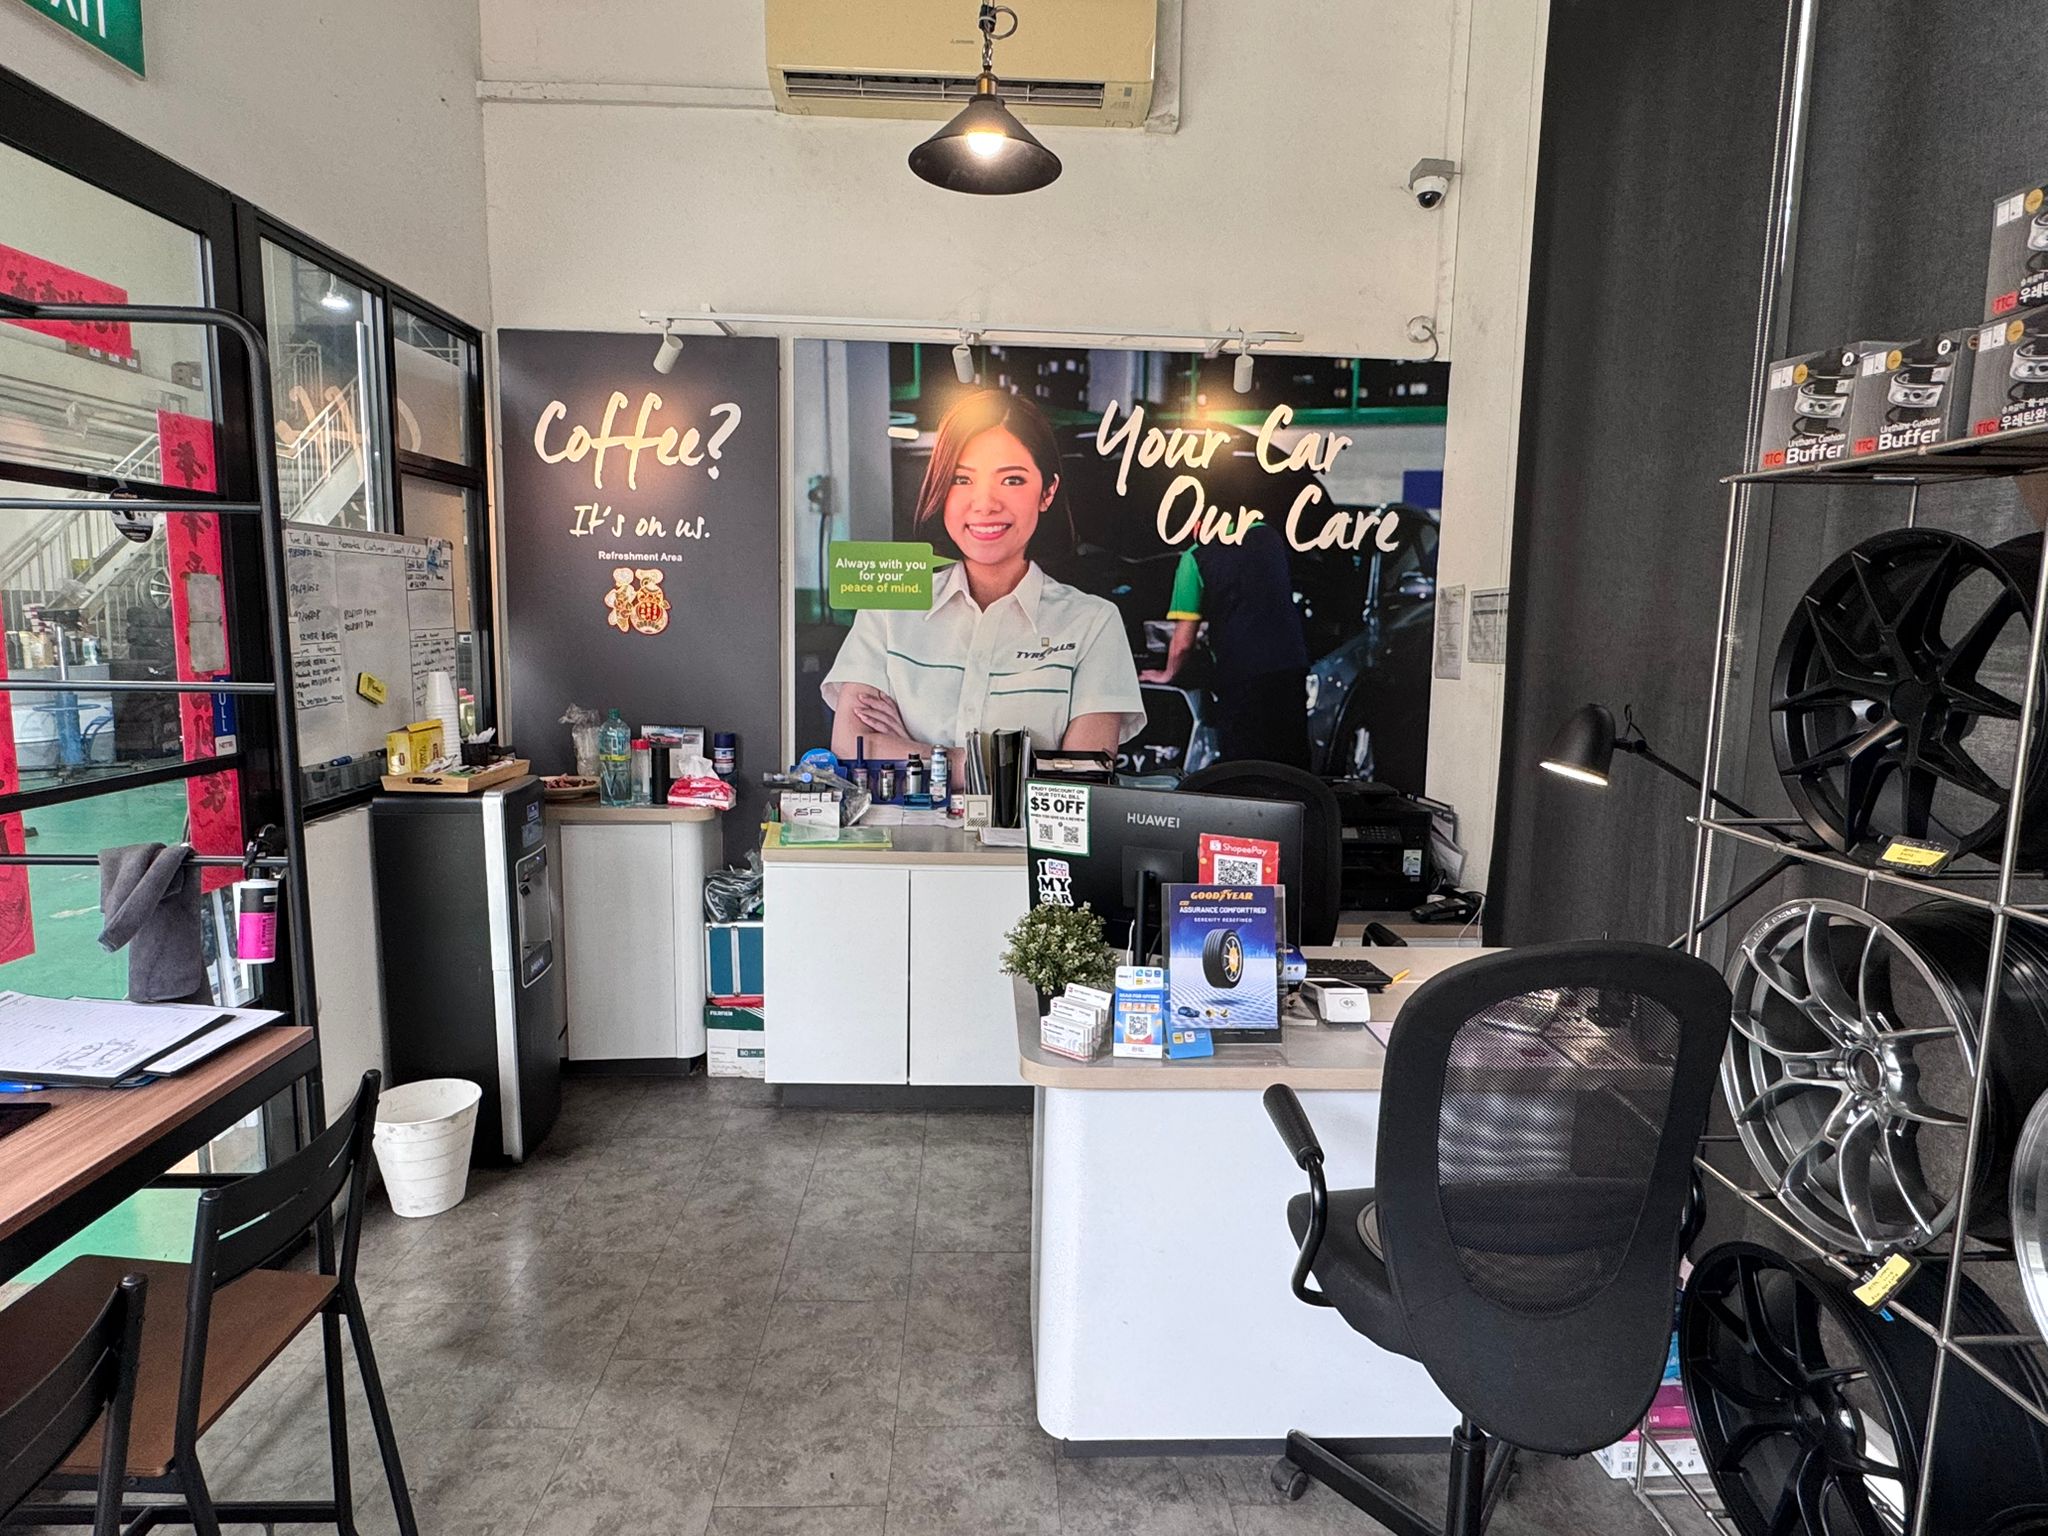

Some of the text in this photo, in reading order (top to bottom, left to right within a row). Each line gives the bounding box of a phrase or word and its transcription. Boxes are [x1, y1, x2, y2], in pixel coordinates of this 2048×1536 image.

[1912, 417, 1941, 429] Cushion
[533, 391, 742, 490] Coffee?
[1818, 432, 1846, 444] Cushion
[1878, 428, 1940, 451] Buffer
[1097, 400, 1353, 496] Your Car
[1785, 444, 1845, 464] Buffer
[1157, 475, 1400, 552] Our Care
[569, 502, 711, 540] It's on us.
[598, 550, 683, 562] Refreshment Area
[835, 558, 927, 571] Always with you
[859, 570, 904, 583] for your
[840, 583, 922, 594] peace of mind.
[1030, 796, 1086, 815] $5 OFF
[1127, 812, 1180, 829] HUAWEI
[1223, 842, 1268, 856] ShopeePay
[1039, 861, 1048, 876] I
[1039, 876, 1070, 892] MY
[1042, 893, 1072, 904] CAR
[1190, 889, 1254, 901] GOODYEAR
[1179, 906, 1218, 914] ASSURANCE
